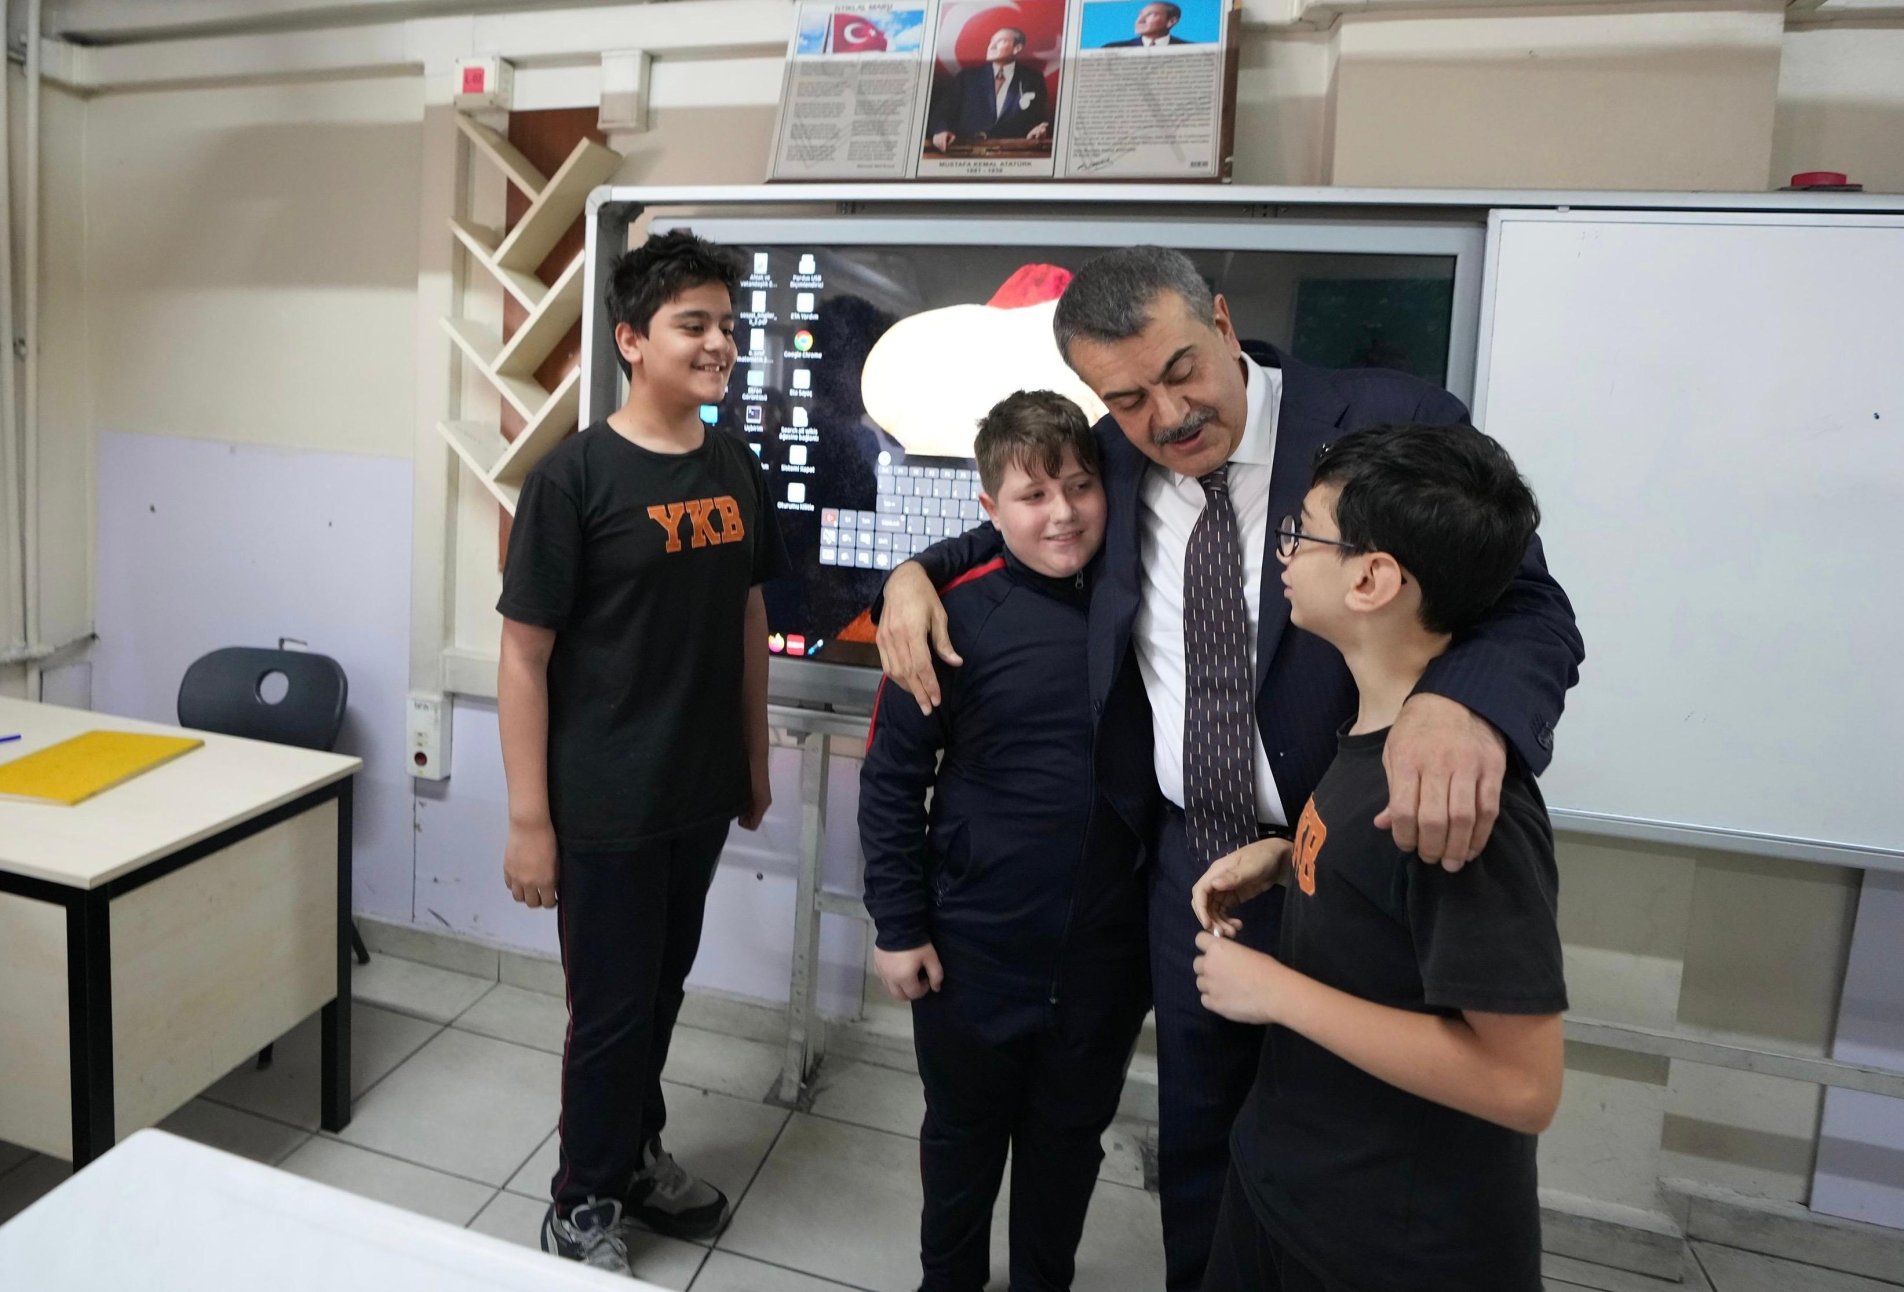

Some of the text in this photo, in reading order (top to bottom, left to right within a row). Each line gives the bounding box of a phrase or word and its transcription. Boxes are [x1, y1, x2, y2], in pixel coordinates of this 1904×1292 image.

[783, 351, 823, 360] Google Chrome
[647, 495, 745, 554] YKB
